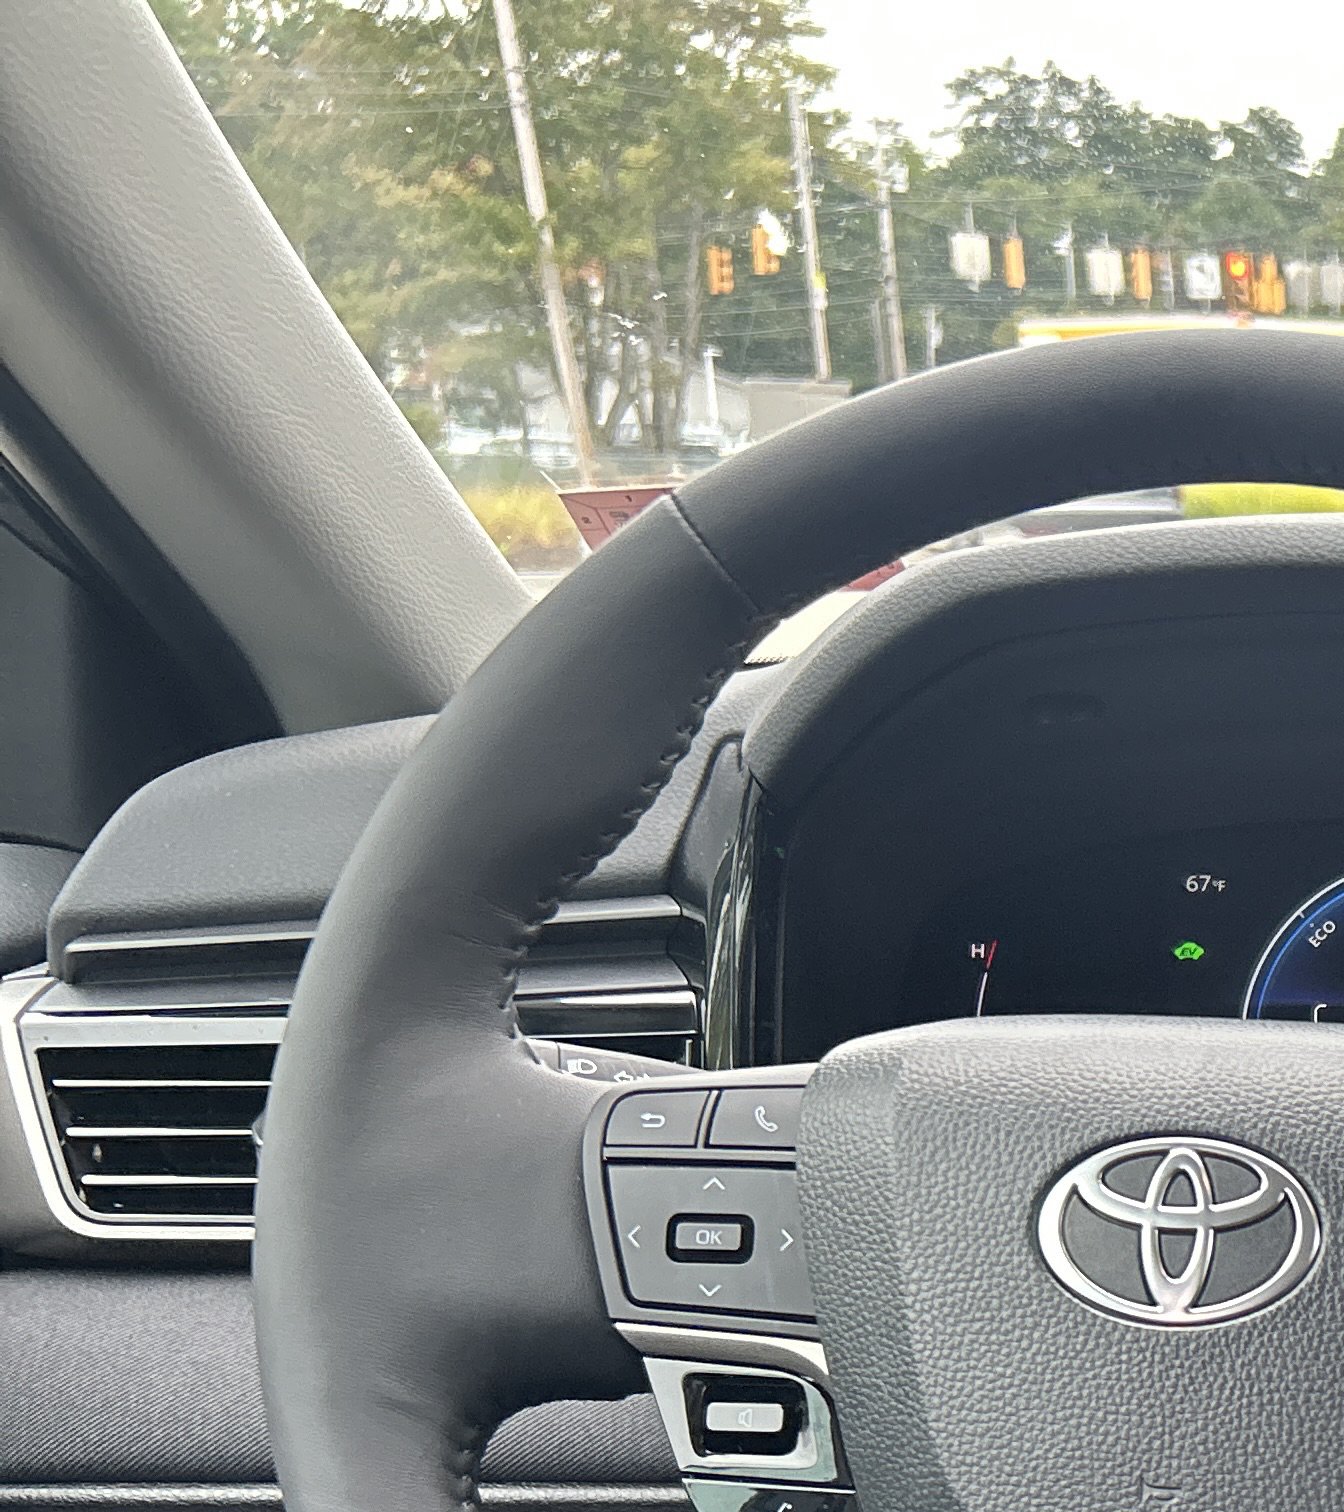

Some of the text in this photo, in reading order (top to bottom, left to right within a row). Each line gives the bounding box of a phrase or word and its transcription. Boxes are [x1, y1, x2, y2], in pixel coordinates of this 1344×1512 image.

[1308, 920, 1336, 948] ECO
[971, 943, 985, 959] H
[695, 1229, 723, 1246] OK
